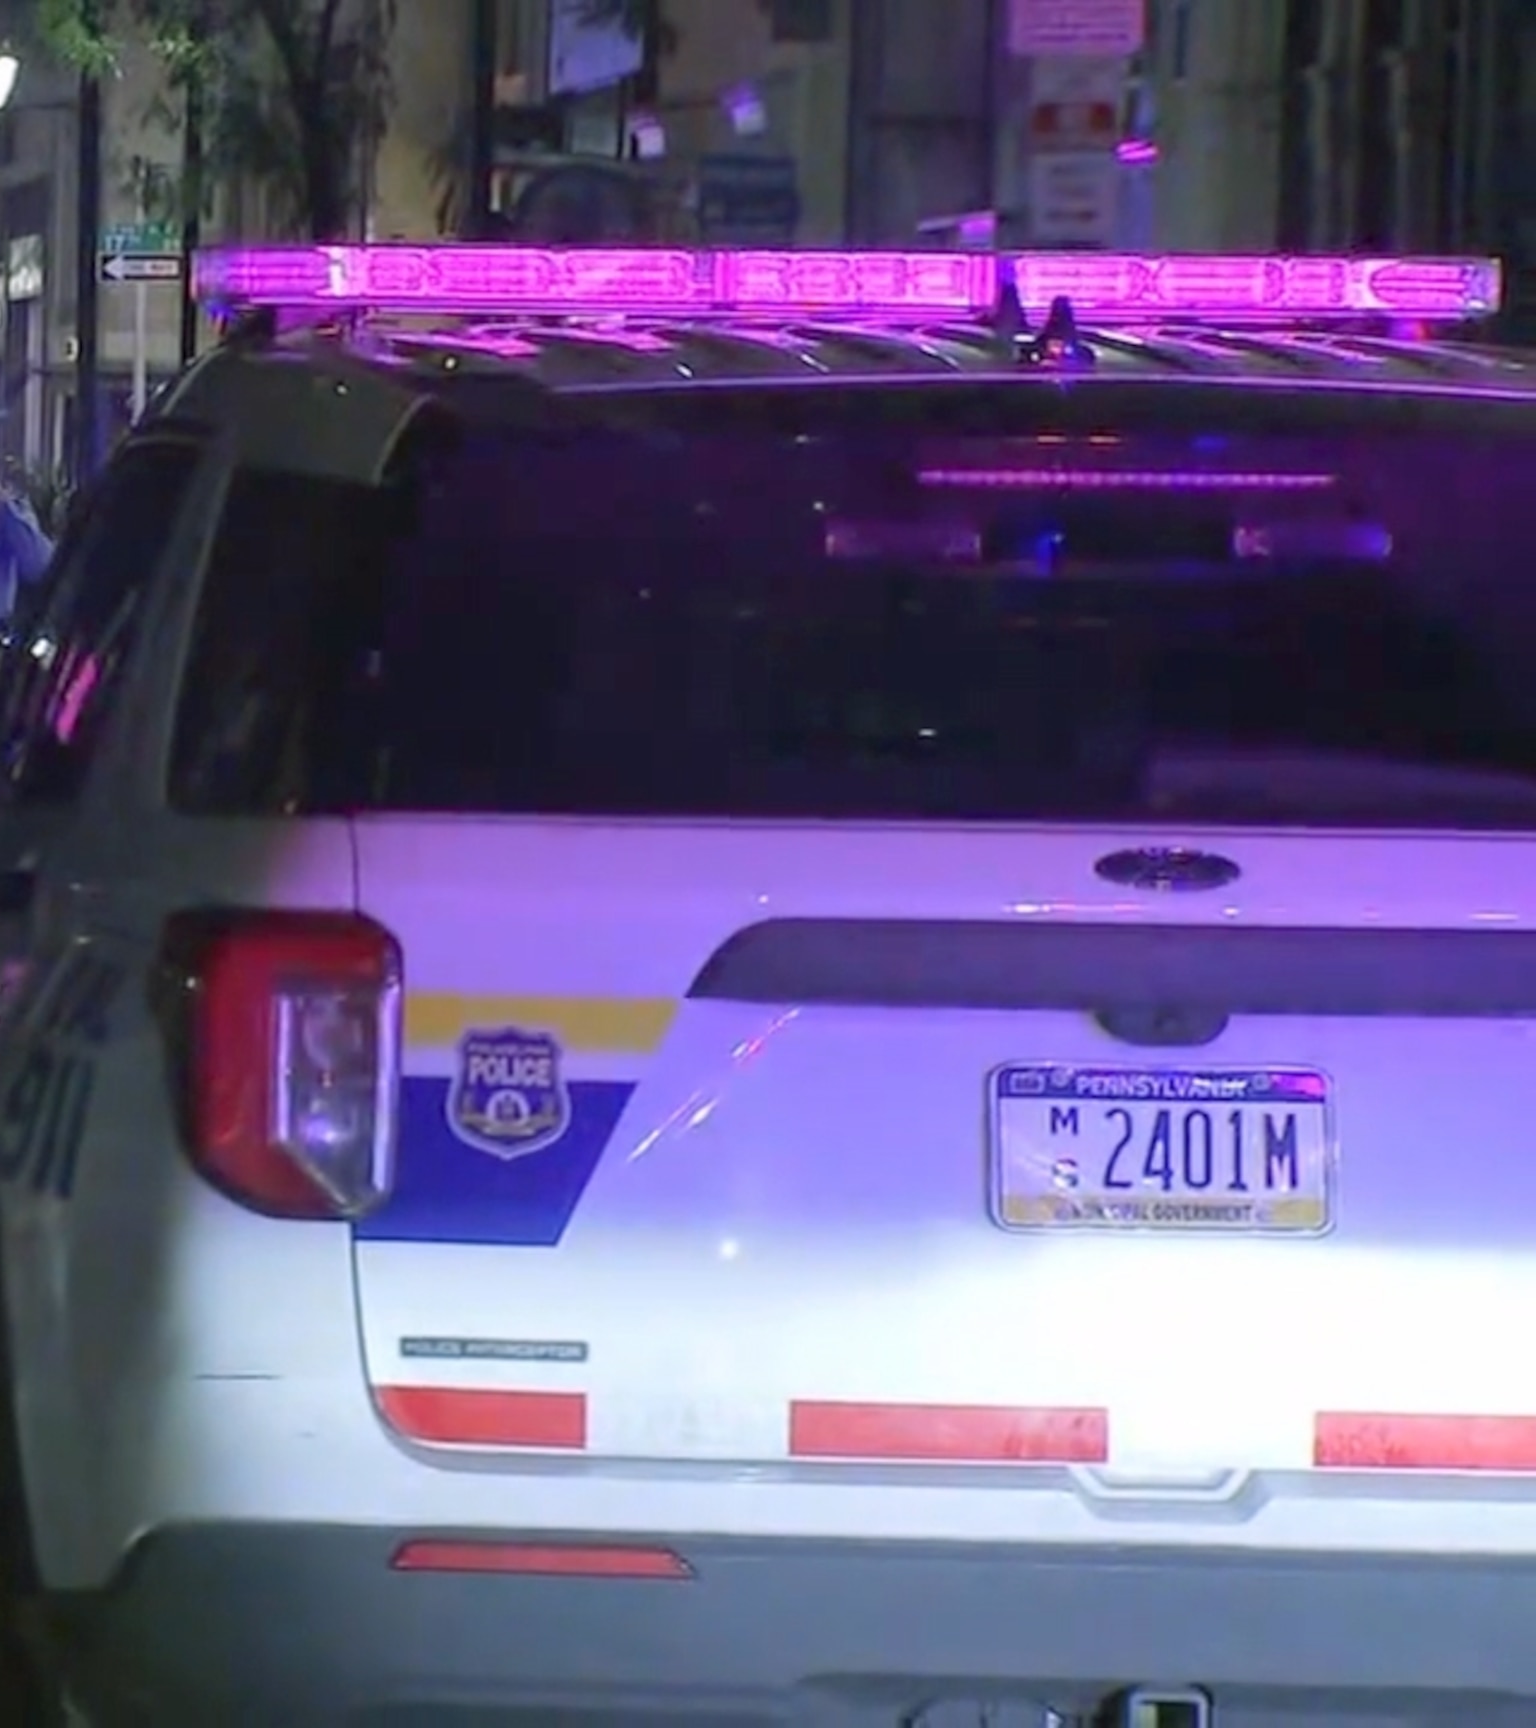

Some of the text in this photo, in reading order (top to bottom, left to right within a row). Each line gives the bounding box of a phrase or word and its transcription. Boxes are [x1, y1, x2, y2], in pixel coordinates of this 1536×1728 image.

[468, 1055, 551, 1088] POLICE
[1050, 1106, 1078, 1135] M
[1103, 1108, 1298, 1191] 2401M
